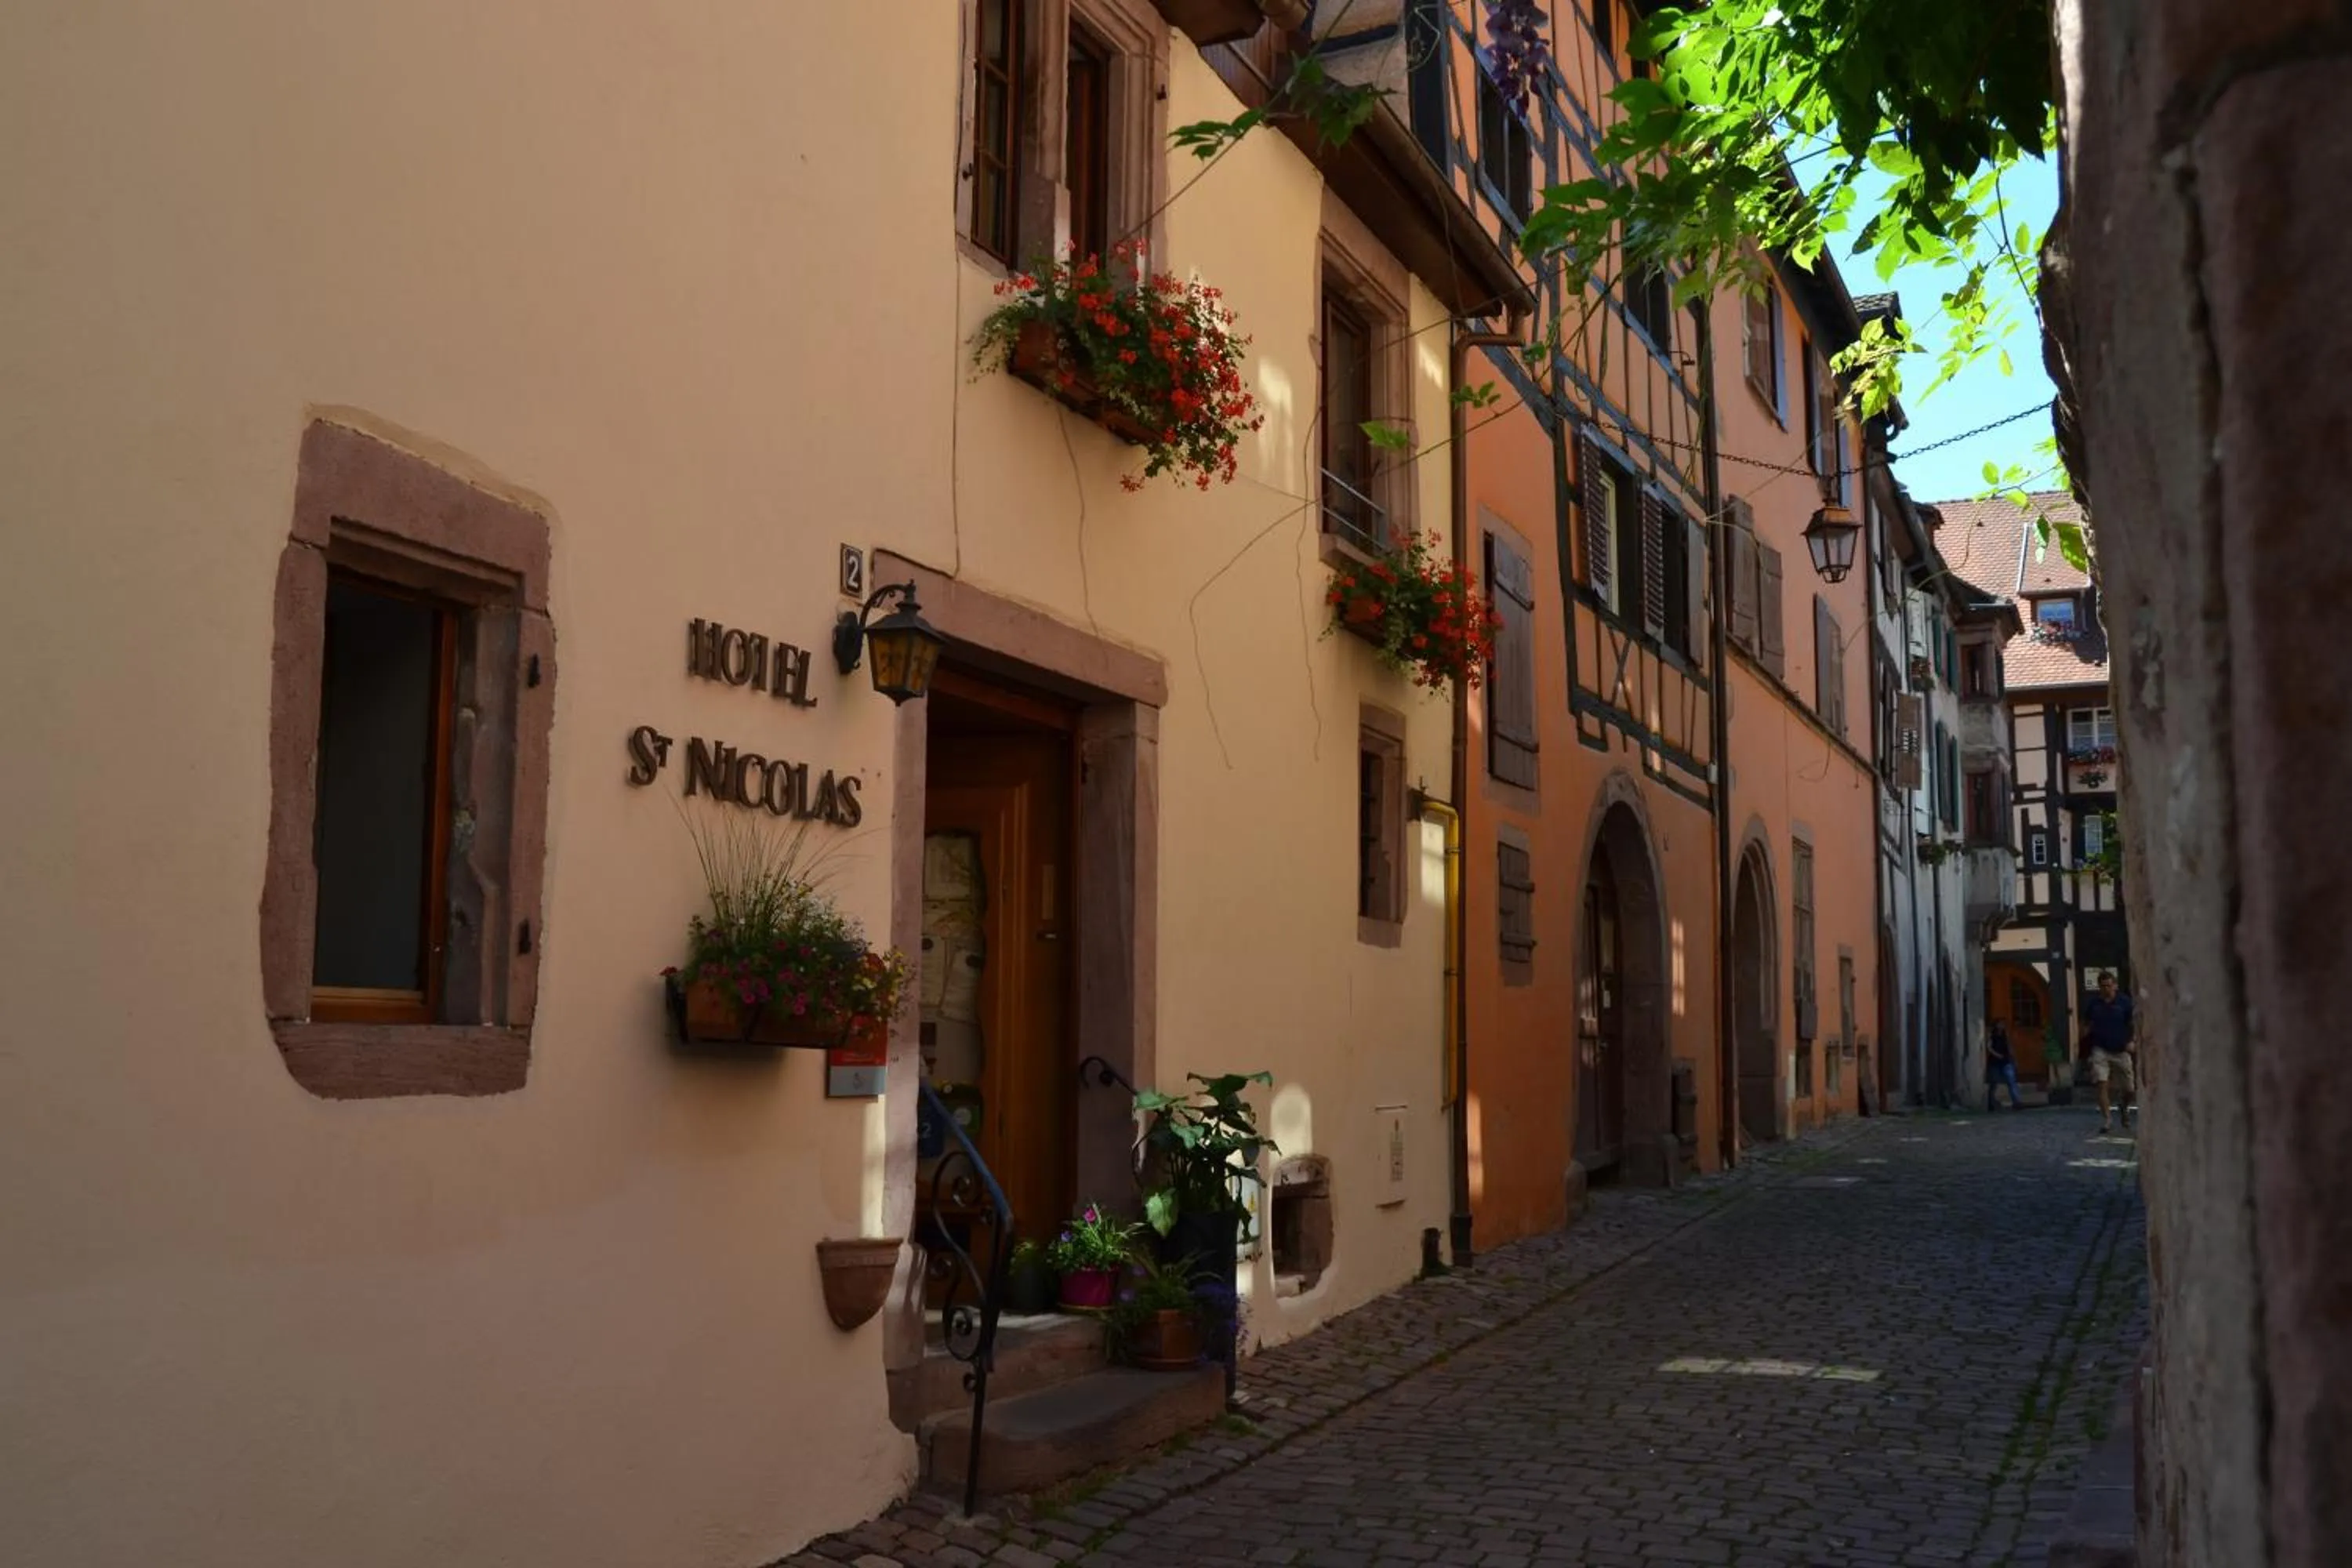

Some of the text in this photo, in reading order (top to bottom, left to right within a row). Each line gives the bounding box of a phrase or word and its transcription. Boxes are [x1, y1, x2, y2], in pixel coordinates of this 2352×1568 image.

[848, 555, 859, 589] 2
[688, 618, 818, 707] HOTEL
[685, 736, 862, 829] NICOLAS
